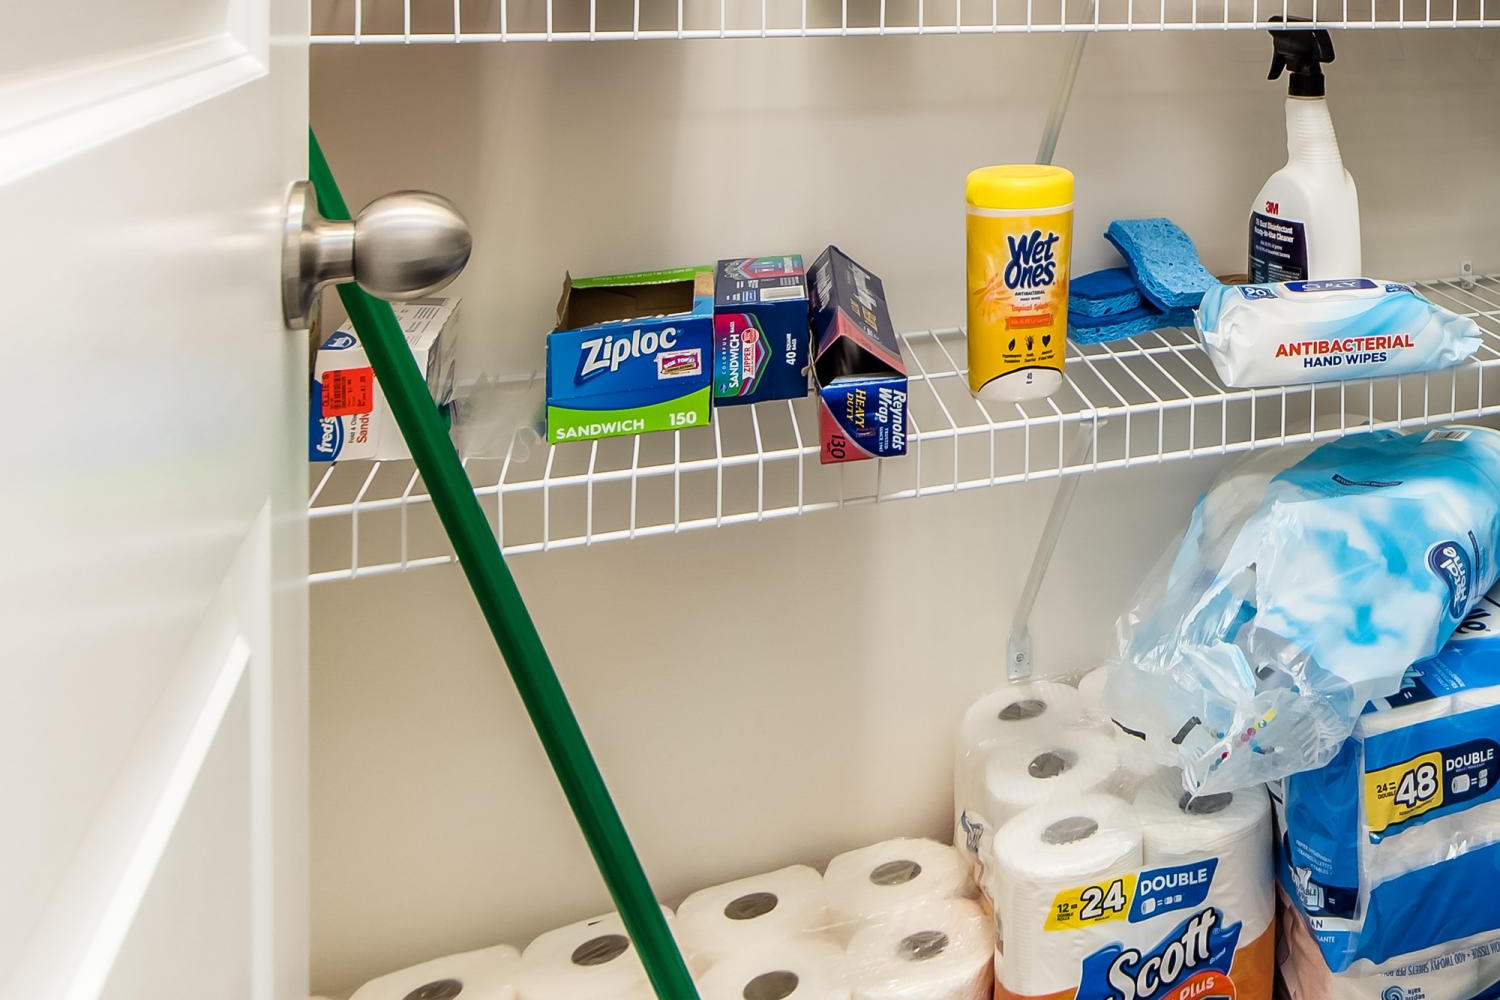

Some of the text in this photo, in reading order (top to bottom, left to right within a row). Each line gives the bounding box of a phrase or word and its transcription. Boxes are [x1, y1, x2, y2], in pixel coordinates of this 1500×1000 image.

[1265, 201, 1279, 216] 3M
[1007, 230, 1060, 266] Wet
[1004, 260, 1056, 290] Ones
[581, 326, 678, 378] Ziploc
[728, 332, 739, 389] SANDWICH
[786, 352, 797, 366] 40
[1275, 334, 1414, 358] ANTIBACTERIAL
[1303, 351, 1387, 369] HAND WIPES
[742, 346, 752, 377] ZIPPER
[846, 392, 854, 421] DUTY
[855, 388, 867, 429] HEAVY
[877, 388, 892, 424] Wrap
[891, 390, 907, 451] Reynolds
[556, 411, 697, 440] SANDWICH 150
[1446, 747, 1494, 772] DOUBLE
[1376, 783, 1388, 793] 24
[1396, 762, 1439, 806] 48
[1140, 868, 1207, 896] DOUBLE
[1057, 904, 1069, 913] 12
[1080, 880, 1127, 920] 24
[1106, 907, 1216, 1000] Scott
[1178, 977, 1215, 1000] Plus
